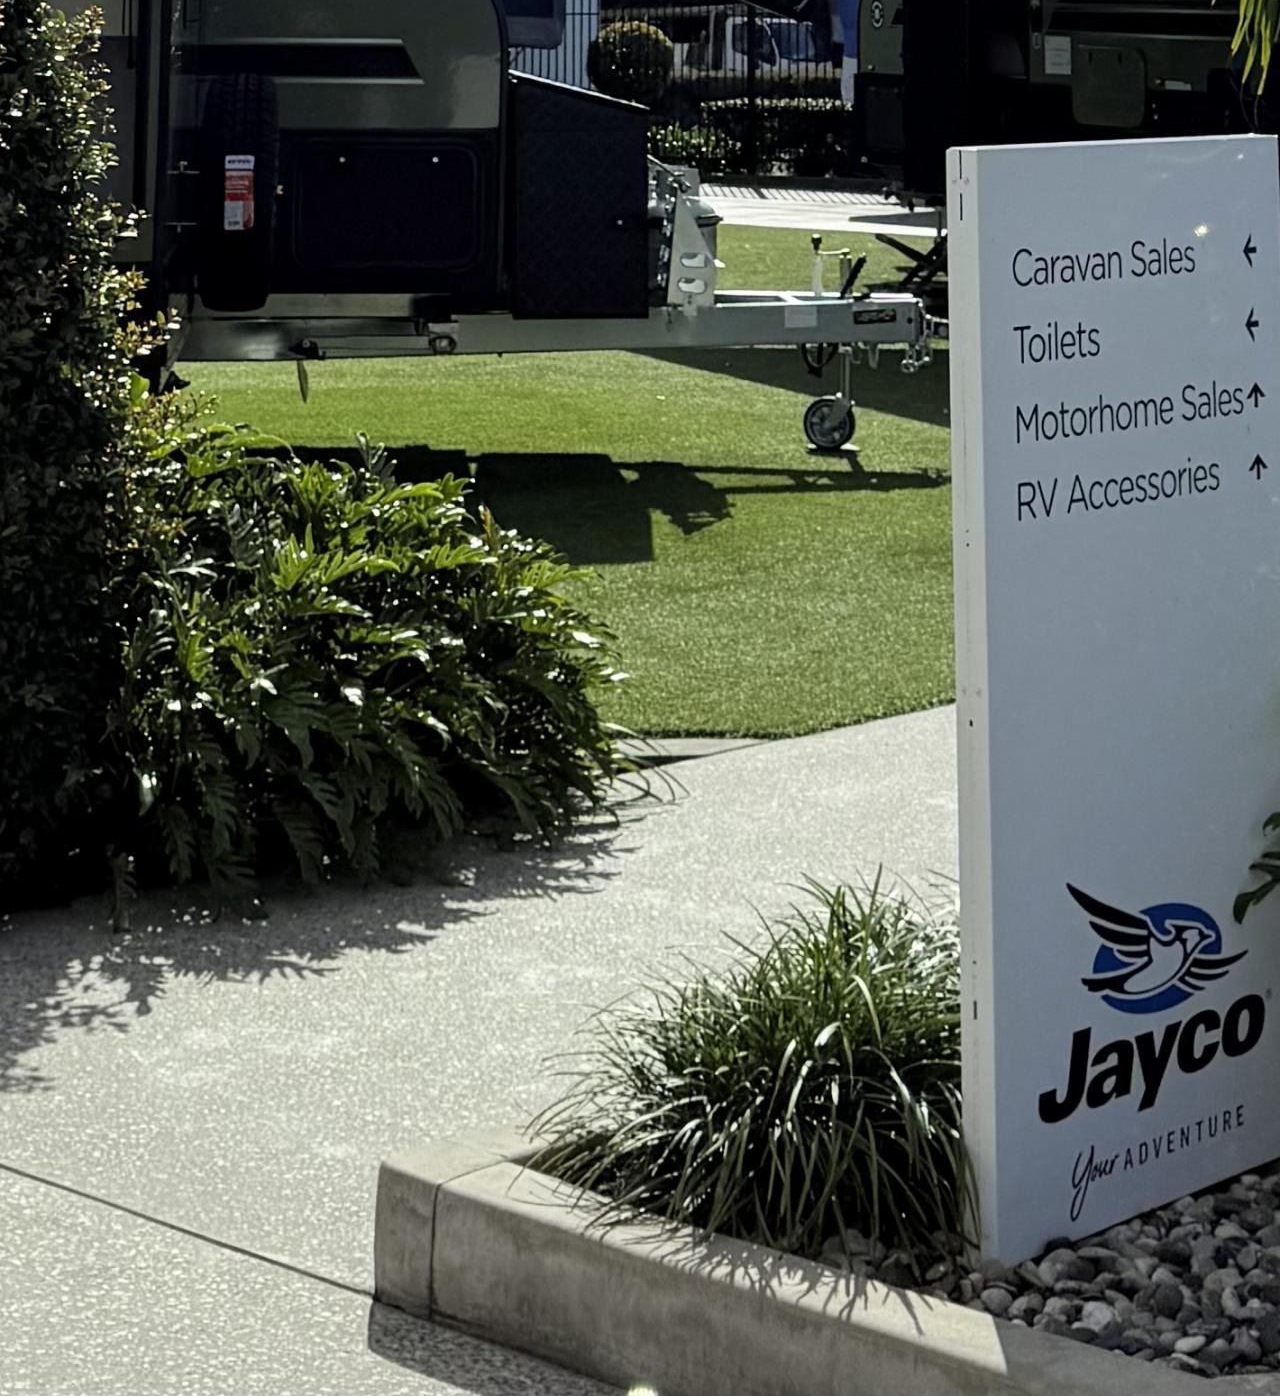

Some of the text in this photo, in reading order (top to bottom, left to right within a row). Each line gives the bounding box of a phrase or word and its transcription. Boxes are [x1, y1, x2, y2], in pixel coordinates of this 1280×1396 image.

[1012, 239, 1196, 287] Caravan Sales
[1013, 322, 1101, 365] Toilets
[1016, 383, 1245, 444] Motorhome Sales
[1017, 459, 1221, 521] RV Accessories
[1038, 993, 1267, 1124] Jayco
[1070, 1105, 1246, 1222] Your ADVENTURE
